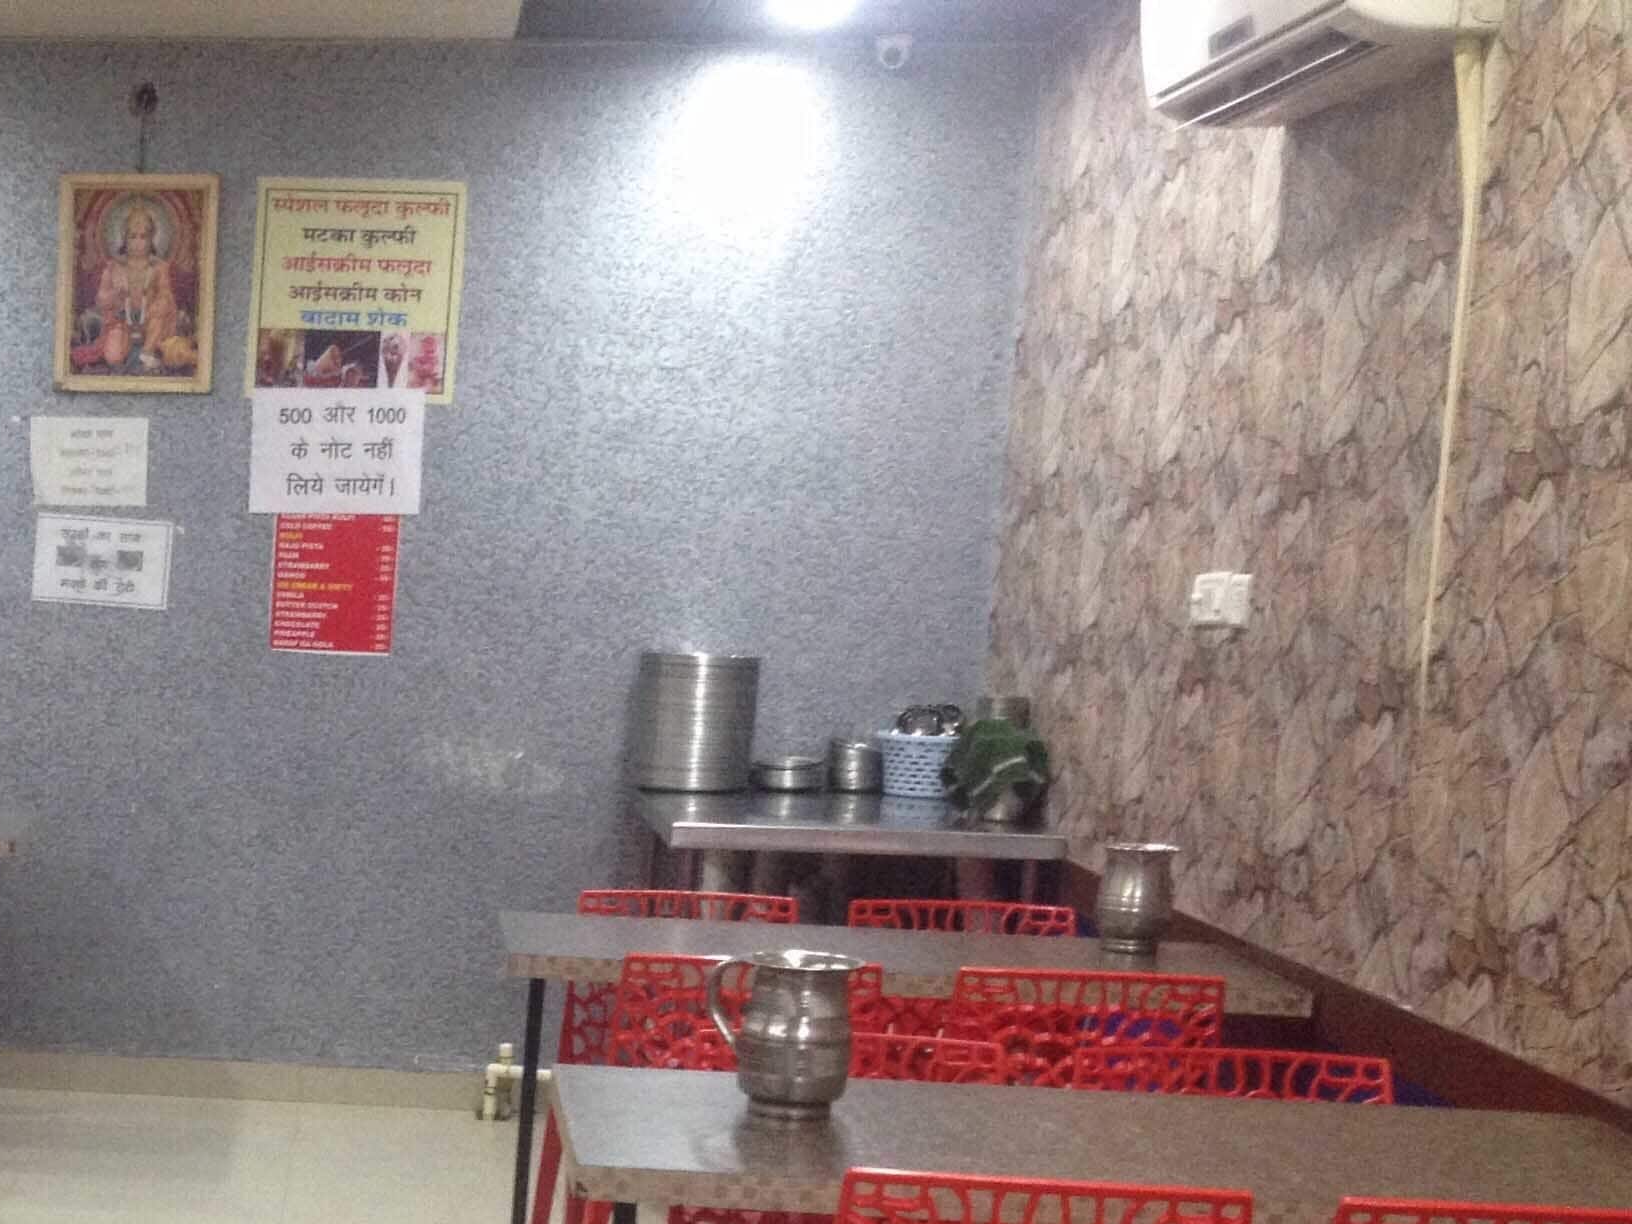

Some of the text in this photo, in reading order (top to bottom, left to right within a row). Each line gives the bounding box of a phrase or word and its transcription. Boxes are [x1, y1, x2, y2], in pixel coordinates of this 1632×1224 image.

[302, 225, 417, 248] मटका कुल्फी
[383, 283, 424, 303] कोन
[279, 407, 312, 424] 500
[367, 407, 406, 424] 1000
[290, 436, 394, 460] के नोट नहीं
[287, 473, 324, 496] लिये
